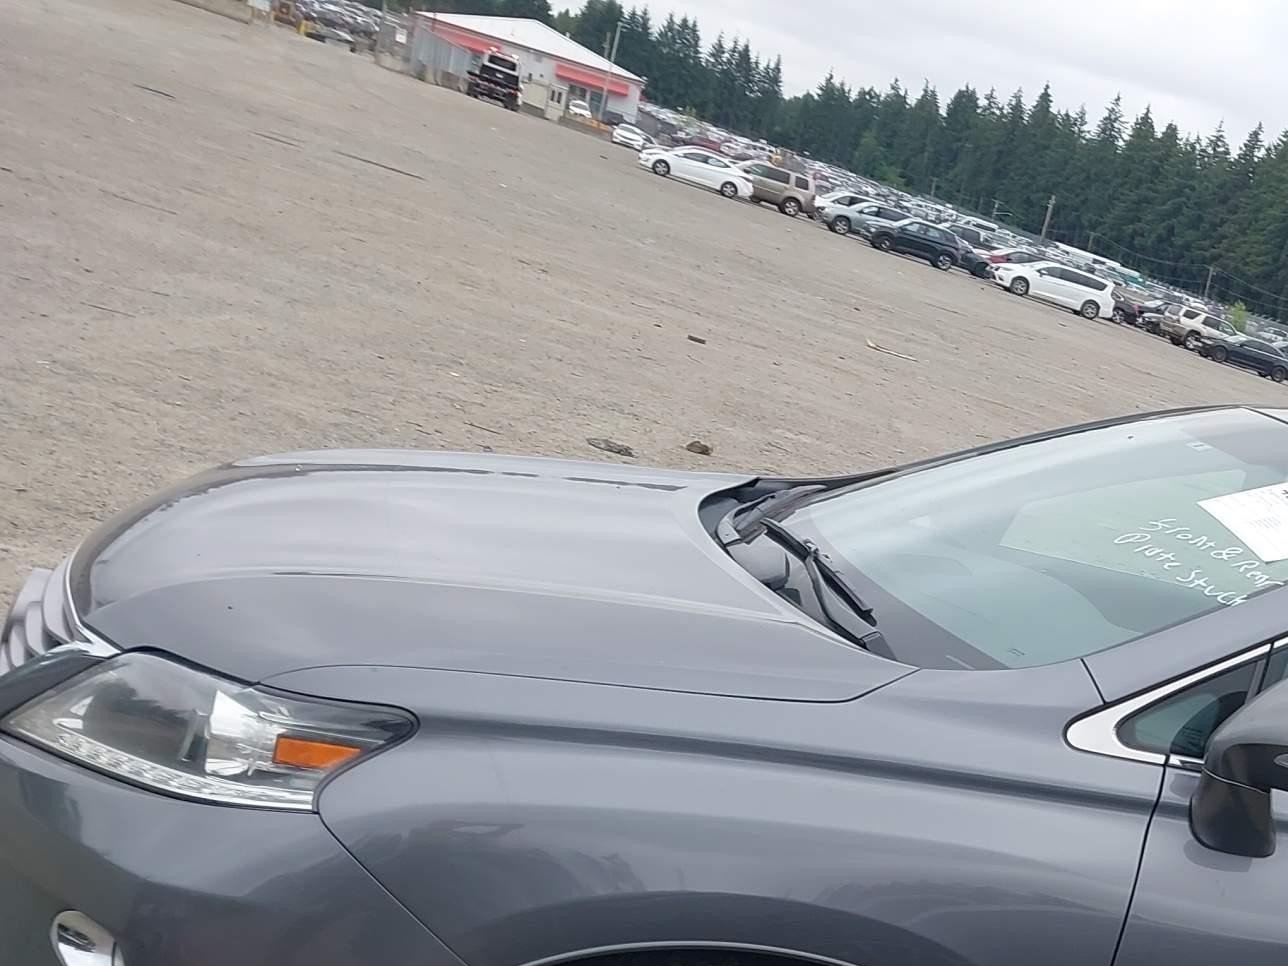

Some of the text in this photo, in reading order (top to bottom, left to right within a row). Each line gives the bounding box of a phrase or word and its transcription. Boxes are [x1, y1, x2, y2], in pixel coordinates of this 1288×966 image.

[1113, 532, 1249, 607] Plate Stuck
[1210, 546, 1244, 561] &
[1231, 559, 1286, 588] Rear
